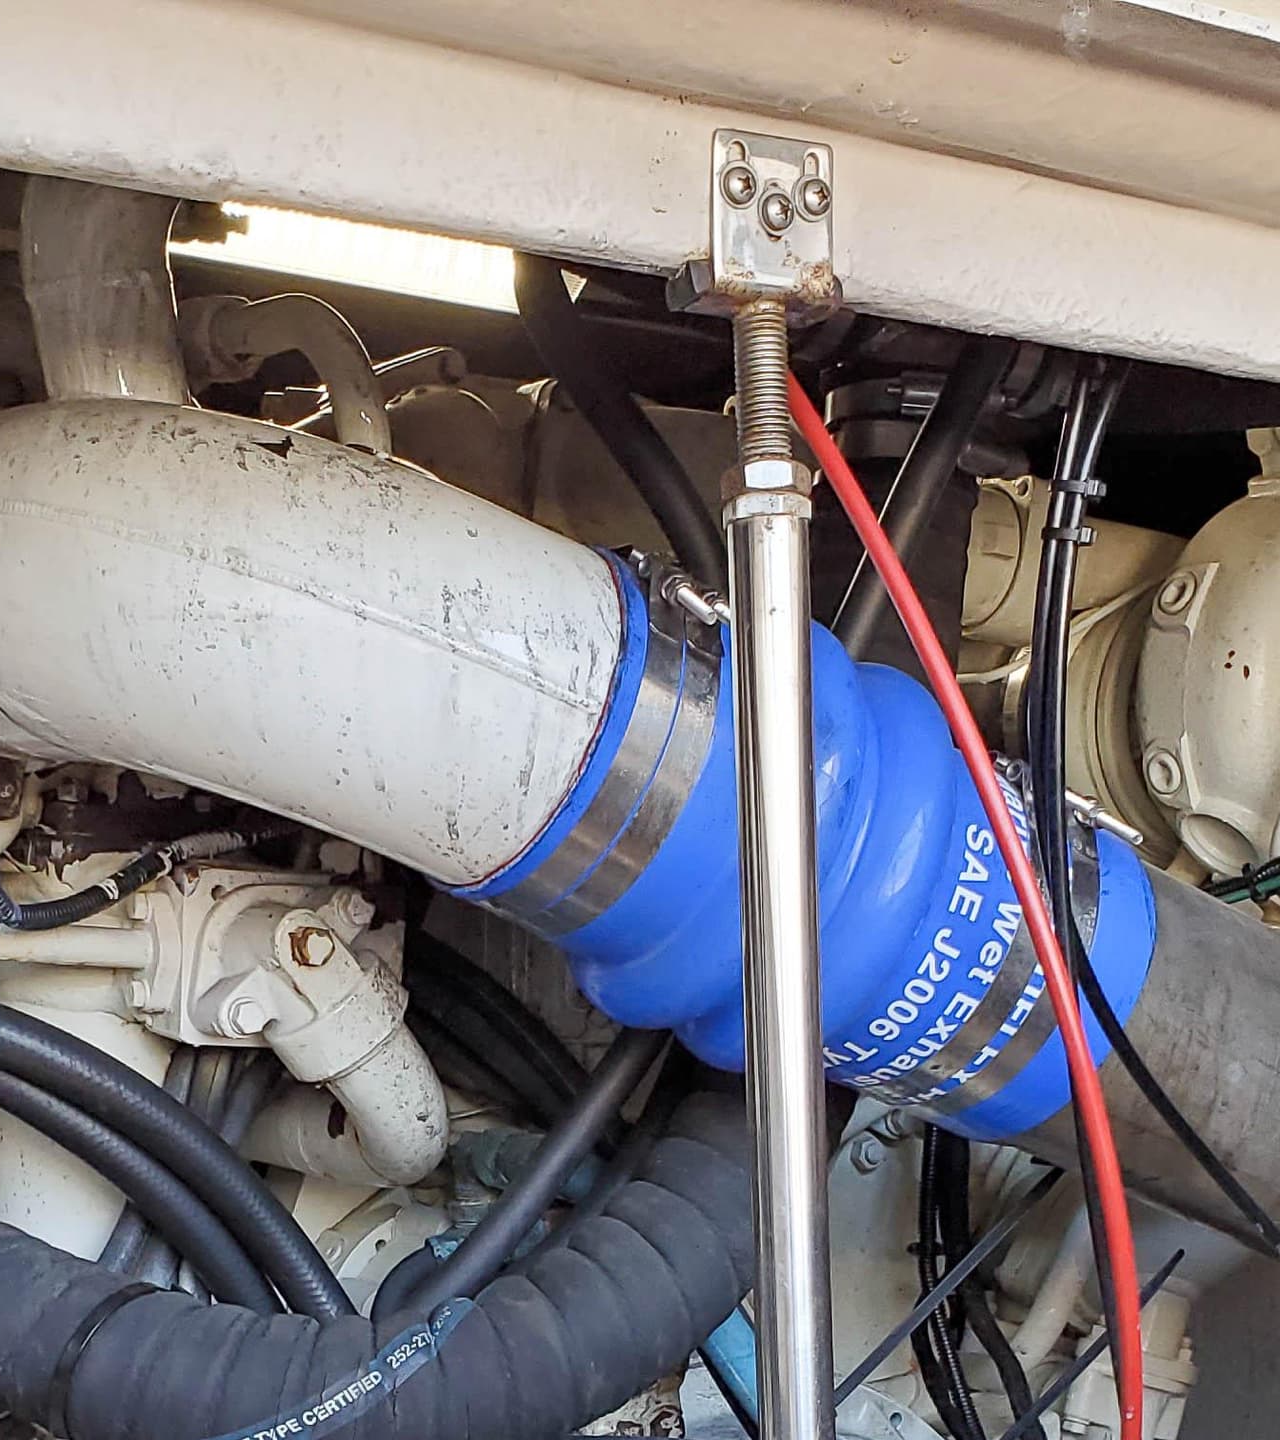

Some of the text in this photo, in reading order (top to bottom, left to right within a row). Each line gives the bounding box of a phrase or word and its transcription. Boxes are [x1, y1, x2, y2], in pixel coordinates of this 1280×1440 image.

[822, 823, 994, 1069] SAE J2006 Ty
[967, 900, 1022, 986] Wet
[842, 991, 984, 1088] Exhaus
[302, 1370, 383, 1427] CERTIFIED
